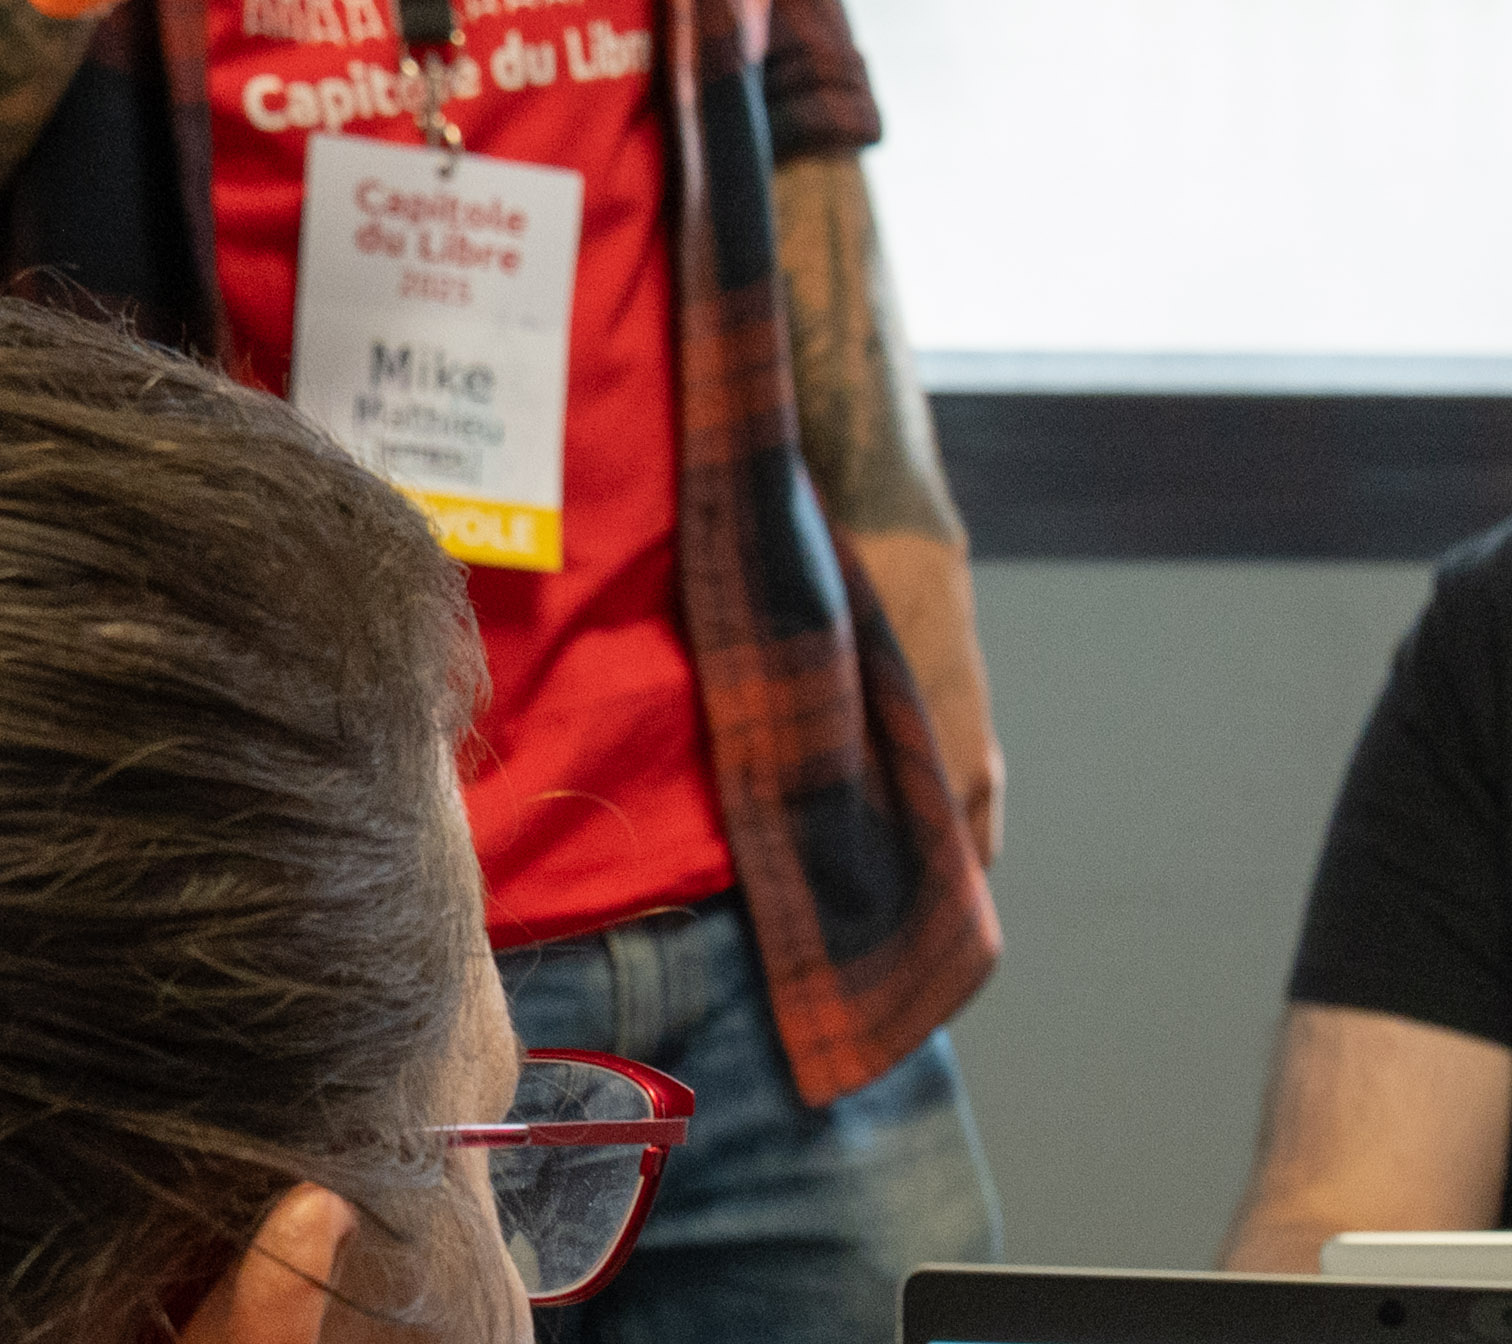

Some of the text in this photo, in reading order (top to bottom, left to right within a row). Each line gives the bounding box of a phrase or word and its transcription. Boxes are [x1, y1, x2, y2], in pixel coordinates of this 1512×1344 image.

[242, 57, 482, 134] Capitoe
[490, 28, 558, 92] du
[354, 177, 528, 239] Capitole
[354, 220, 522, 276] du Libre
[369, 338, 496, 404] Mike
